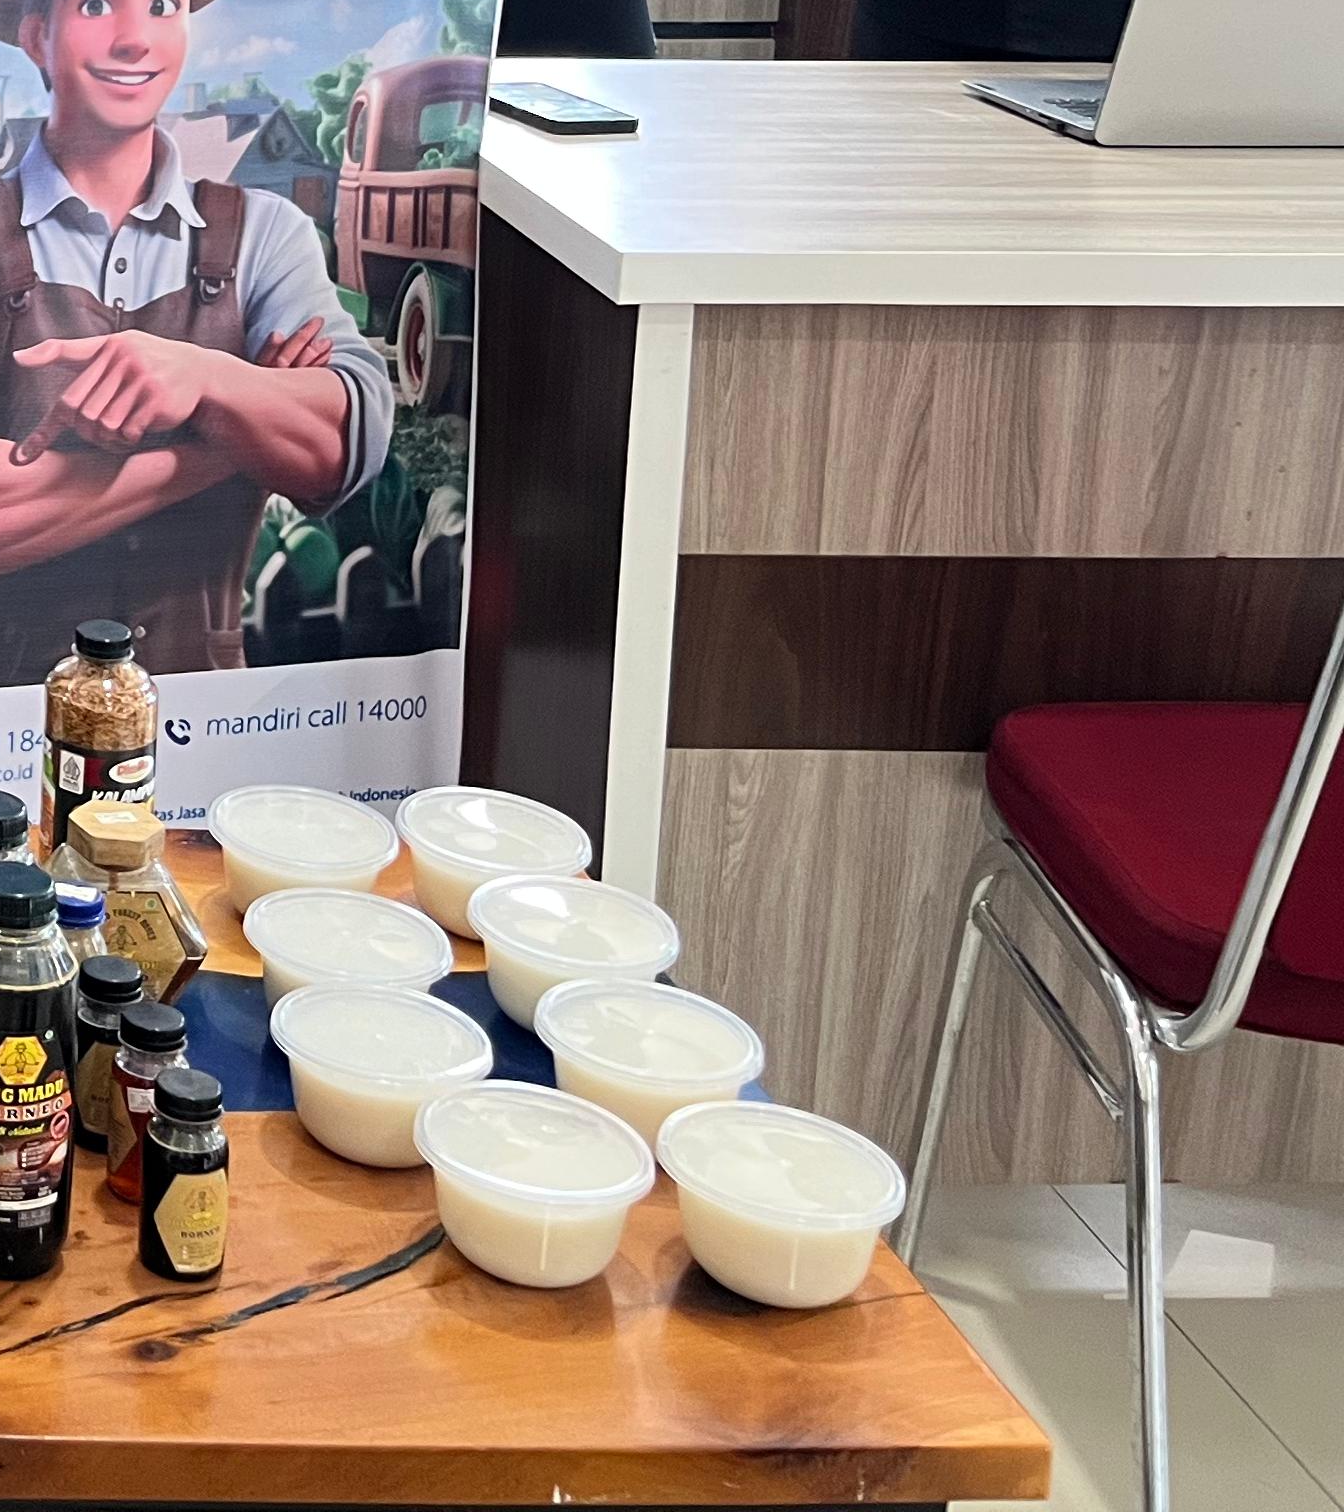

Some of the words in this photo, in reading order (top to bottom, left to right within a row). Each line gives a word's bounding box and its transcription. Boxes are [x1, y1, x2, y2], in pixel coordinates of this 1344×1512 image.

[206, 705, 301, 736] mandiri
[308, 700, 348, 728] call
[356, 694, 427, 723] 14000
[177, 805, 206, 820] Jasa
[18, 1078, 64, 1103] MADU
